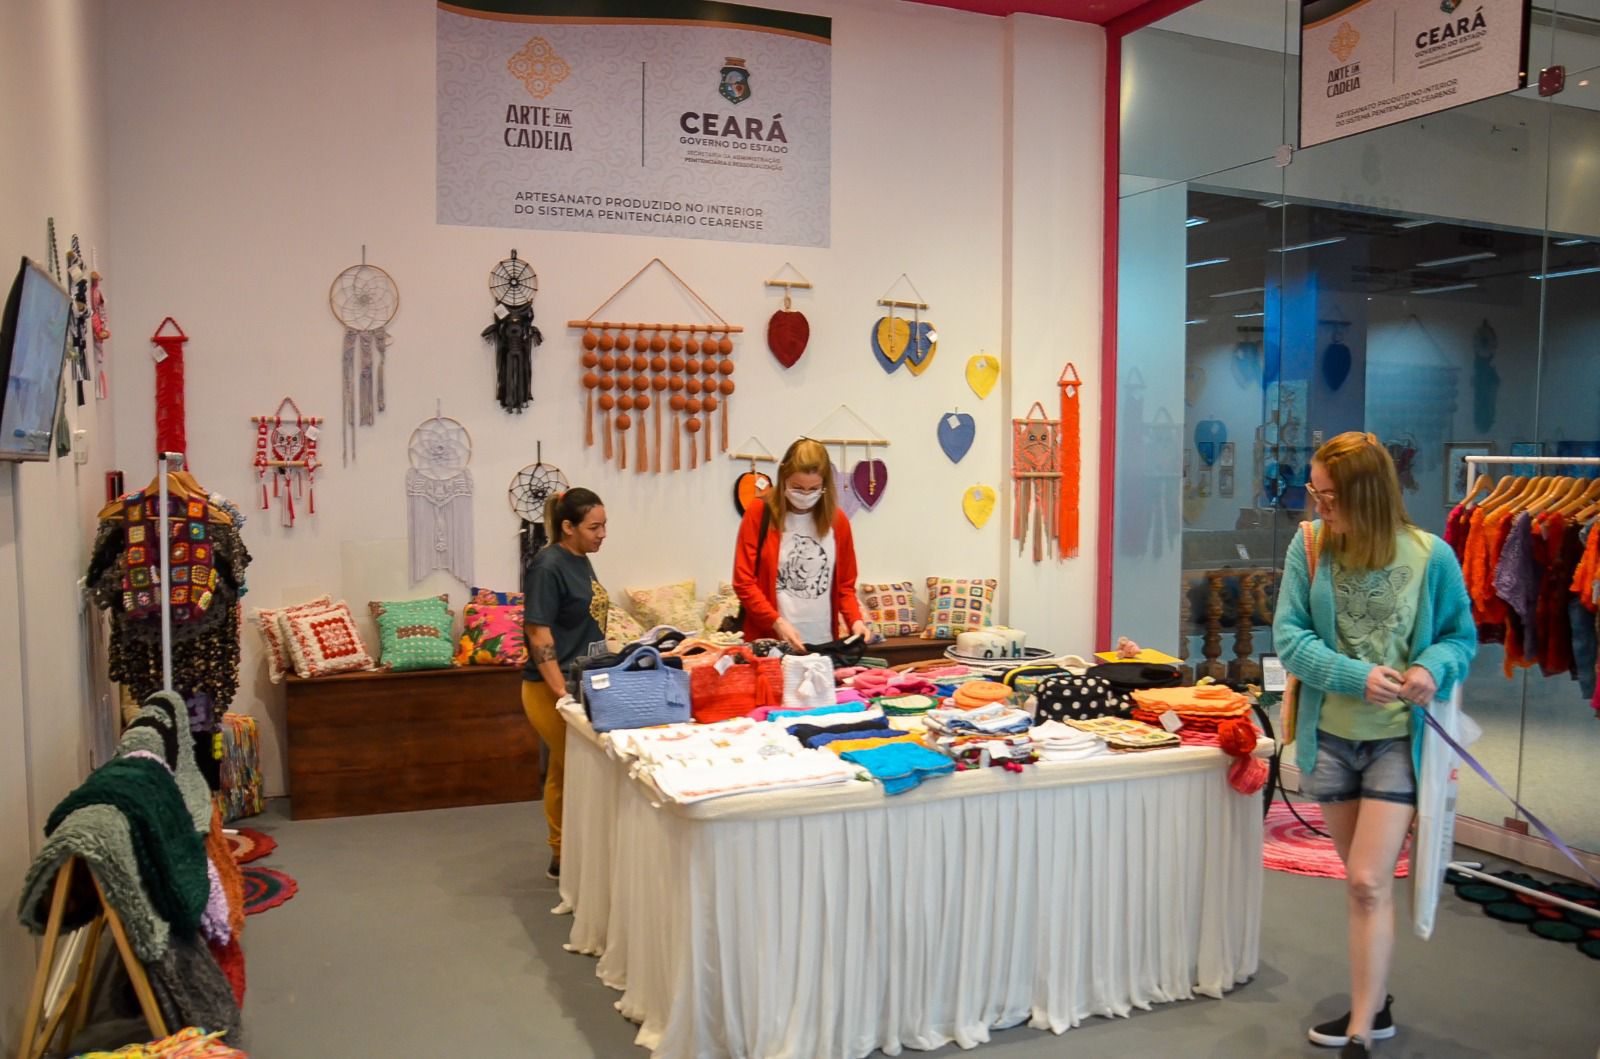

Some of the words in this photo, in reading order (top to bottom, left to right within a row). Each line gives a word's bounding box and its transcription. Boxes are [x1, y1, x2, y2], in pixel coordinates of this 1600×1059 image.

[1416, 6, 1486, 49] CEARÁ
[1448, 40, 1457, 48] DO
[1328, 65, 1350, 83] ARTE
[1327, 77, 1360, 98] CADEIA
[1411, 89, 1422, 98] NO
[1423, 79, 1457, 94] INTERIOR
[505, 104, 551, 127] ARTE
[555, 111, 572, 126] EM
[680, 111, 788, 144] CEARÁ
[503, 127, 573, 152] CADEIA
[680, 136, 729, 149] GOVERNO
[732, 141, 748, 150] DO
[750, 143, 788, 154] ESTADO
[515, 191, 602, 206] ARTESANATO
[605, 197, 682, 211] PRODUZIDO
[685, 203, 703, 213] NO
[707, 205, 763, 217] INTERIOR
[514, 204, 534, 214] DO
[538, 206, 594, 218] SISTEMA
[598, 209, 696, 225] PENITENCIÁRIO
[699, 217, 763, 230] CEARENSE
